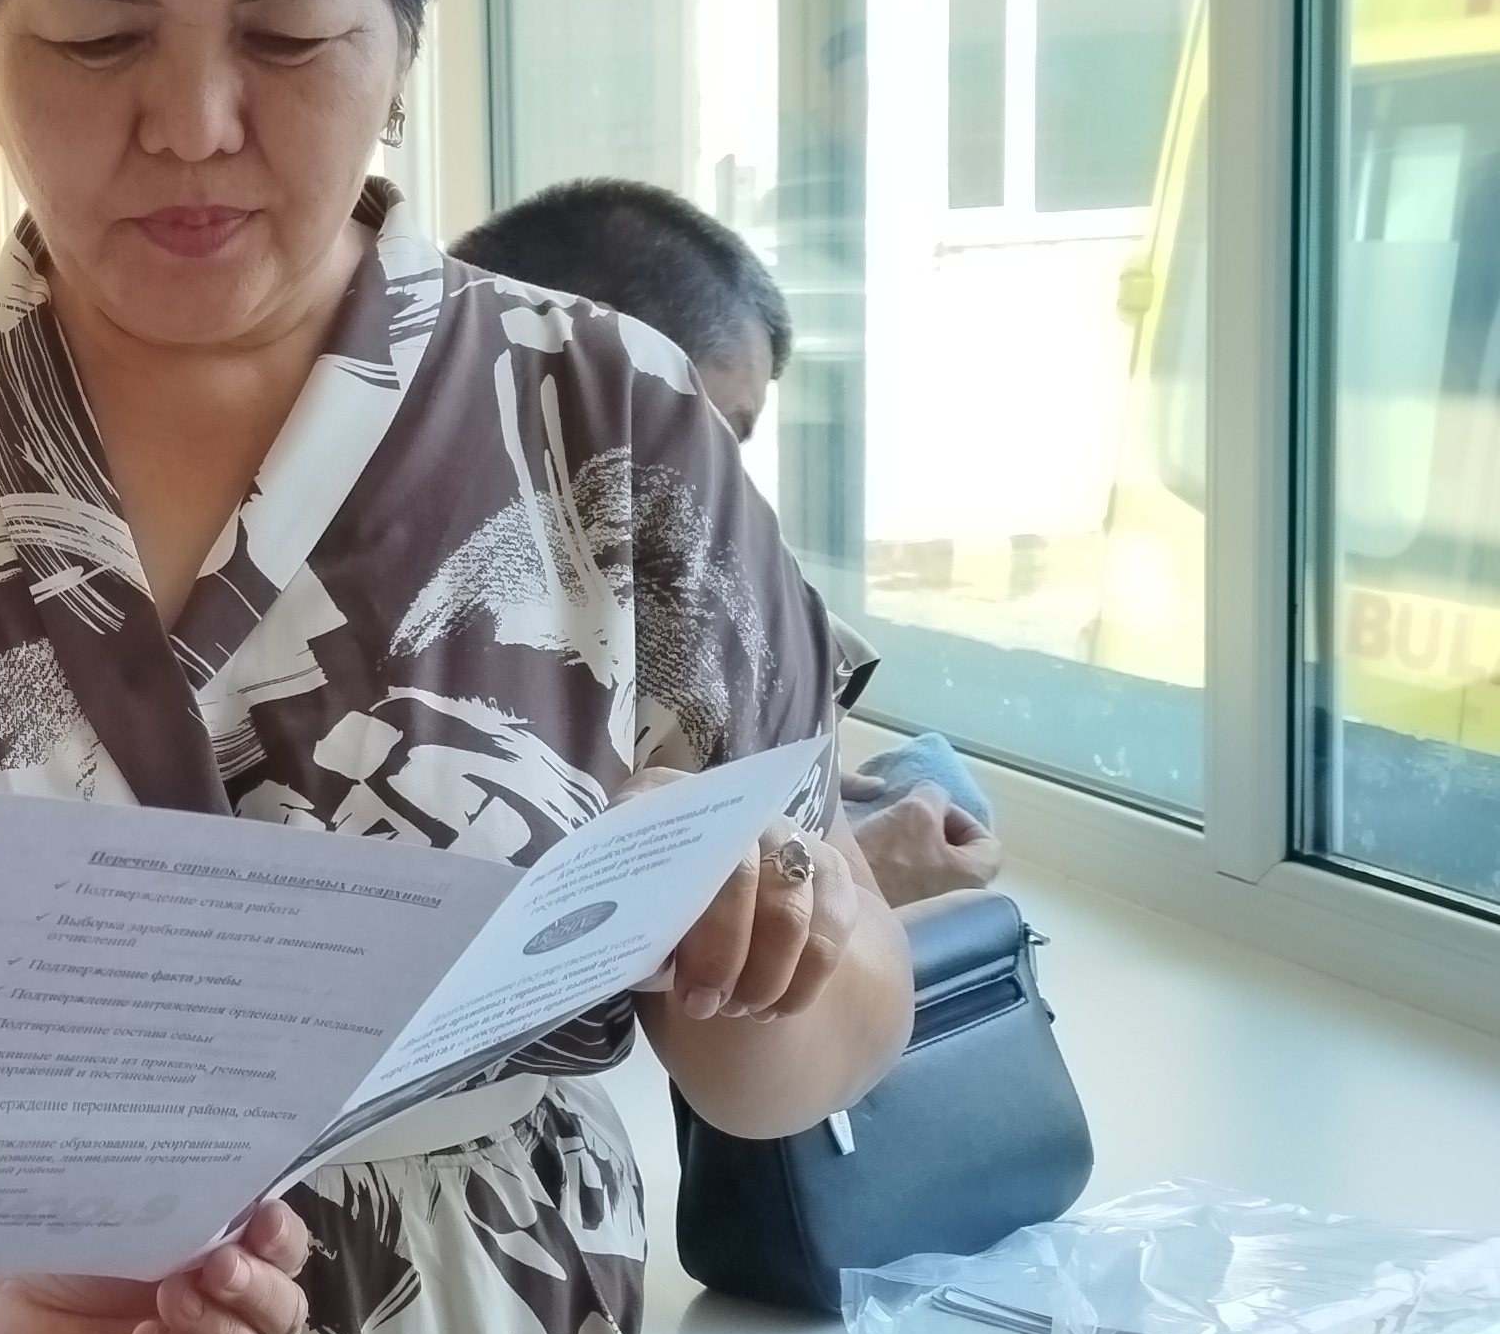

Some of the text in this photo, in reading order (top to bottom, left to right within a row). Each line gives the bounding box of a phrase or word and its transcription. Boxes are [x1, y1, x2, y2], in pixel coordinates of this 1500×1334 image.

[88, 850, 442, 907] Перечень справок, выдаваемых госархивом
[75, 883, 300, 916] Подтверждение стажа работы
[47, 932, 137, 947] отчислений
[57, 914, 368, 957] Выборка заработной платы и пенсионных
[28, 958, 243, 987] Подтверждение факта учебы
[10, 988, 384, 1037] Подтверждение награждения орденами и медалями
[112, 1026, 167, 1040] состава
[170, 1030, 214, 1045] семьи
[55, 1054, 118, 1066] выписки
[121, 1057, 138, 1067] из
[210, 1064, 277, 1081] решений,
[76, 1069, 87, 1078] и
[89, 1069, 197, 1084] постановлений
[72, 1099, 185, 1117] переименования
[187, 1103, 239, 1119] района,
[243, 1106, 298, 1121] области
[59, 1137, 148, 1152] образования,
